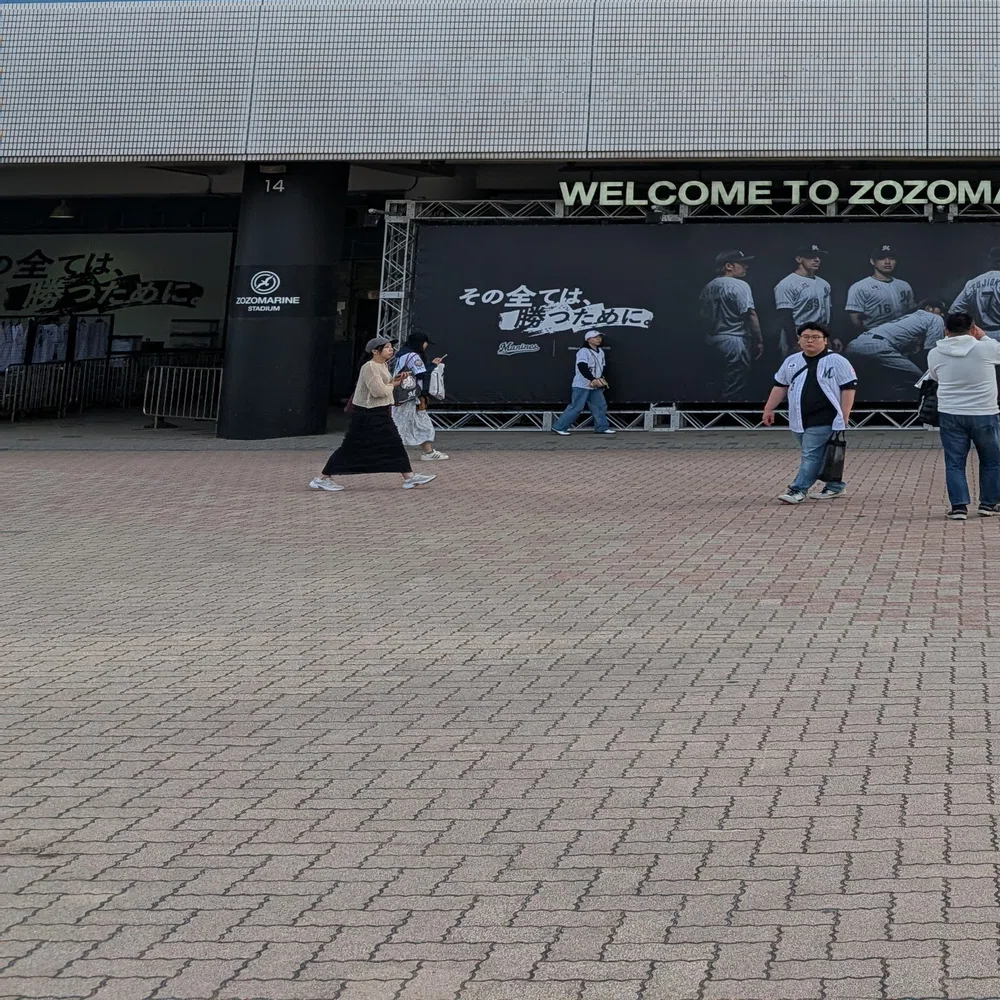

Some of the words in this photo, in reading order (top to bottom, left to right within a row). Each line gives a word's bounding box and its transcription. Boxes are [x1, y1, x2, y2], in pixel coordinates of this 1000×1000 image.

[265, 180, 285, 192] 14
[559, 180, 773, 206] WELCOME
[783, 180, 839, 205] TO
[459, 285, 591, 307] その全ては、
[513, 307, 651, 328] 勝つために。
[497, 341, 540, 355] Marines
